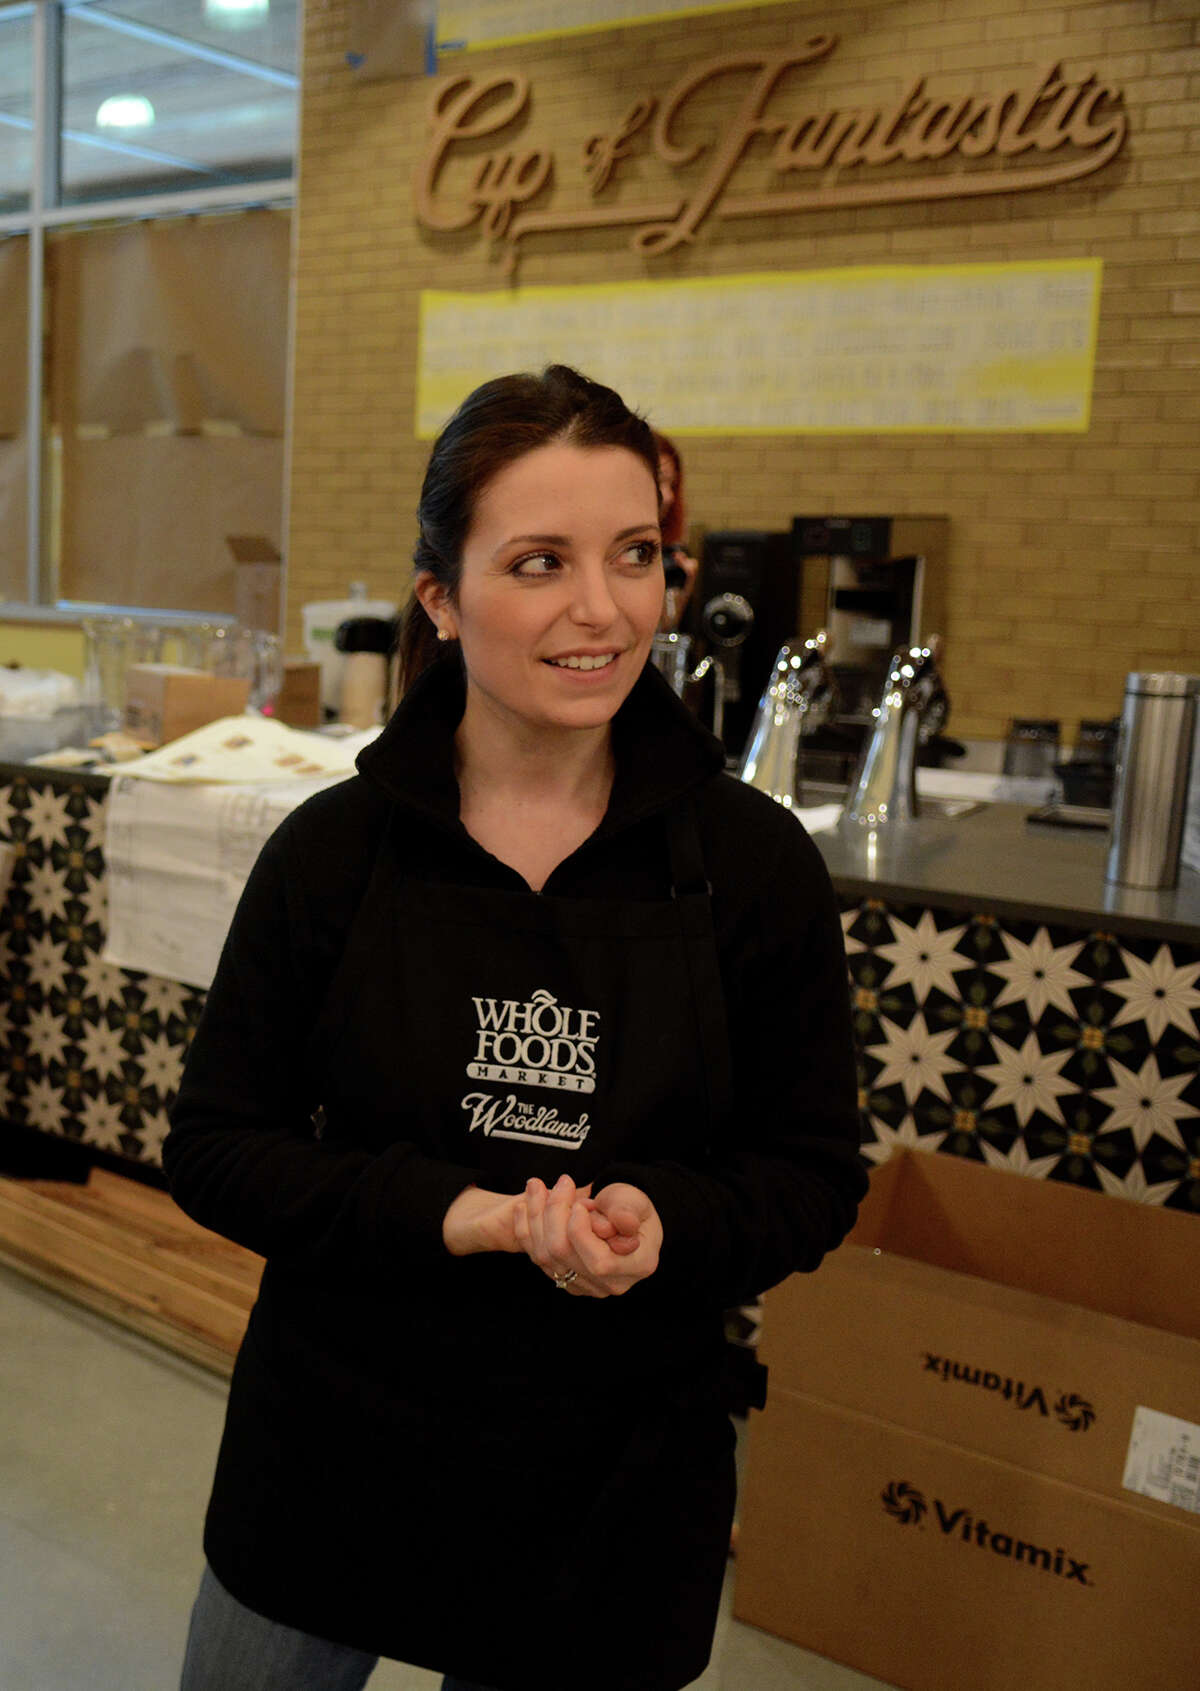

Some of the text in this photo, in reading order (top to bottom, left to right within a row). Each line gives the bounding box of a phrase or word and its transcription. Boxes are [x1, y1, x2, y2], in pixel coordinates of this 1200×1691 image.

[413, 33, 1126, 255] Cup of Fantastic
[471, 989, 601, 1043] WHOLE
[473, 1030, 597, 1077] FOODS
[475, 1064, 587, 1092] MARKET
[461, 1092, 591, 1144] Woodlands
[518, 1102, 535, 1116] THE
[922, 1352, 1049, 1418] Vitamix
[933, 1499, 1090, 1586] Vitamix
